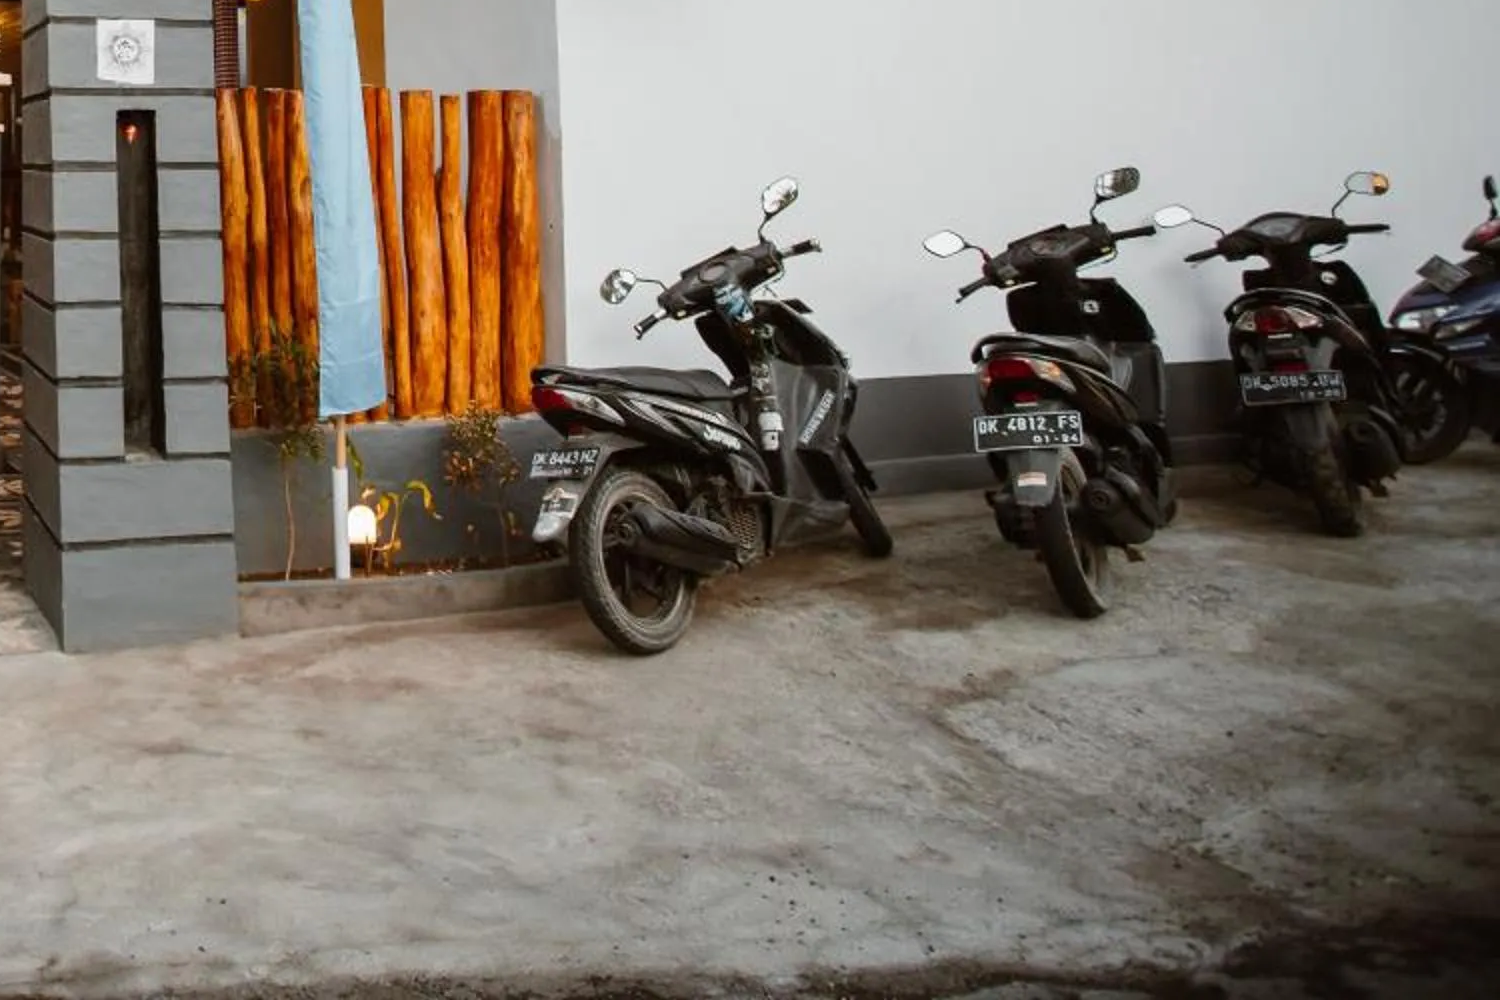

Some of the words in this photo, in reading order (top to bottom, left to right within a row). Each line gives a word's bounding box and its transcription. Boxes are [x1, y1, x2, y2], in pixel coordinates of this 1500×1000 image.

[979, 419, 999, 435] DK
[1007, 416, 1047, 431] 4812
[1057, 414, 1080, 430] FS
